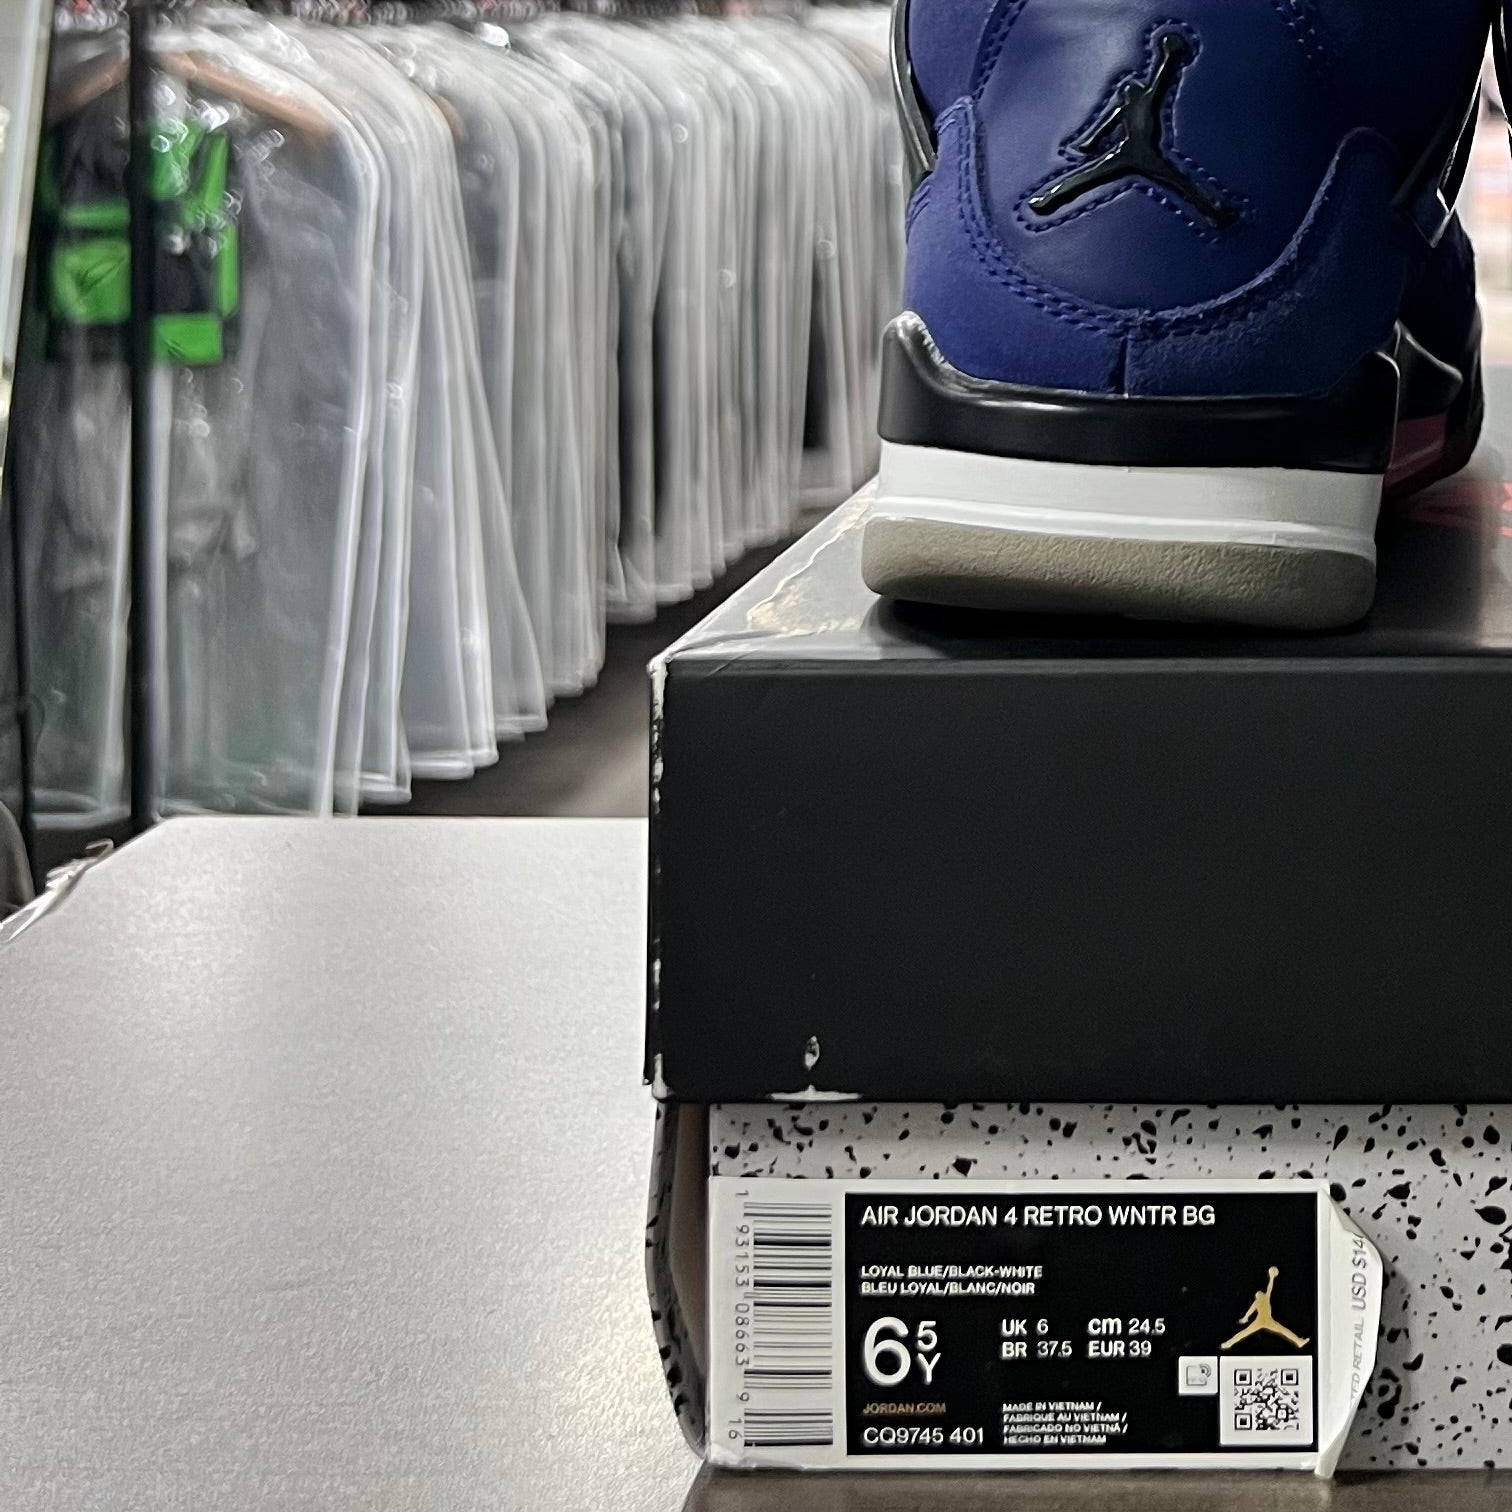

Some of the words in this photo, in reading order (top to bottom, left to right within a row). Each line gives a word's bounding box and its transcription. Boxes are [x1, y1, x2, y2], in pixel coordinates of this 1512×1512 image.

[861, 1205, 899, 1226] AIR
[904, 1205, 998, 1227] JORDAN
[1004, 1206, 1018, 1226] 4
[1023, 1205, 1103, 1226] RETRO
[1108, 1205, 1177, 1225] WNTR
[1182, 1205, 1216, 1225] BG
[735, 1224, 750, 1288] 93153
[860, 1265, 905, 1278] LOYAL
[907, 1265, 1043, 1278] BLUE/BLACK-WHITE
[860, 1281, 898, 1295] BLEU
[900, 1281, 1036, 1295] LOYAL/BLANC/NOIR
[1352, 1272, 1366, 1311] USD
[735, 1303, 750, 1367] 08663
[1001, 1318, 1028, 1336] UK
[1036, 1318, 1049, 1336] 6
[1127, 1317, 1166, 1335] 24.5
[863, 1316, 912, 1386] 6
[916, 1320, 938, 1352] 5
[1001, 1341, 1028, 1358] BR
[1036, 1340, 1073, 1358] 37.5
[1087, 1339, 1126, 1358] EUR
[1129, 1339, 1153, 1357] 39
[1352, 1317, 1365, 1369] RETAIL
[916, 1352, 942, 1385] Y
[862, 1402, 947, 1415] JORDAN.COM
[1002, 1403, 1033, 1413] MADE
[1034, 1402, 1047, 1411] IN
[1048, 1401, 1095, 1412] VIETNAM
[1056, 1412, 1072, 1422] AU
[1073, 1412, 1120, 1422] VIETNAM
[727, 1417, 743, 1440] 16
[862, 1426, 944, 1445] CQ9745
[949, 1426, 985, 1444] 401
[1060, 1434, 1107, 1445] VIETNAM
